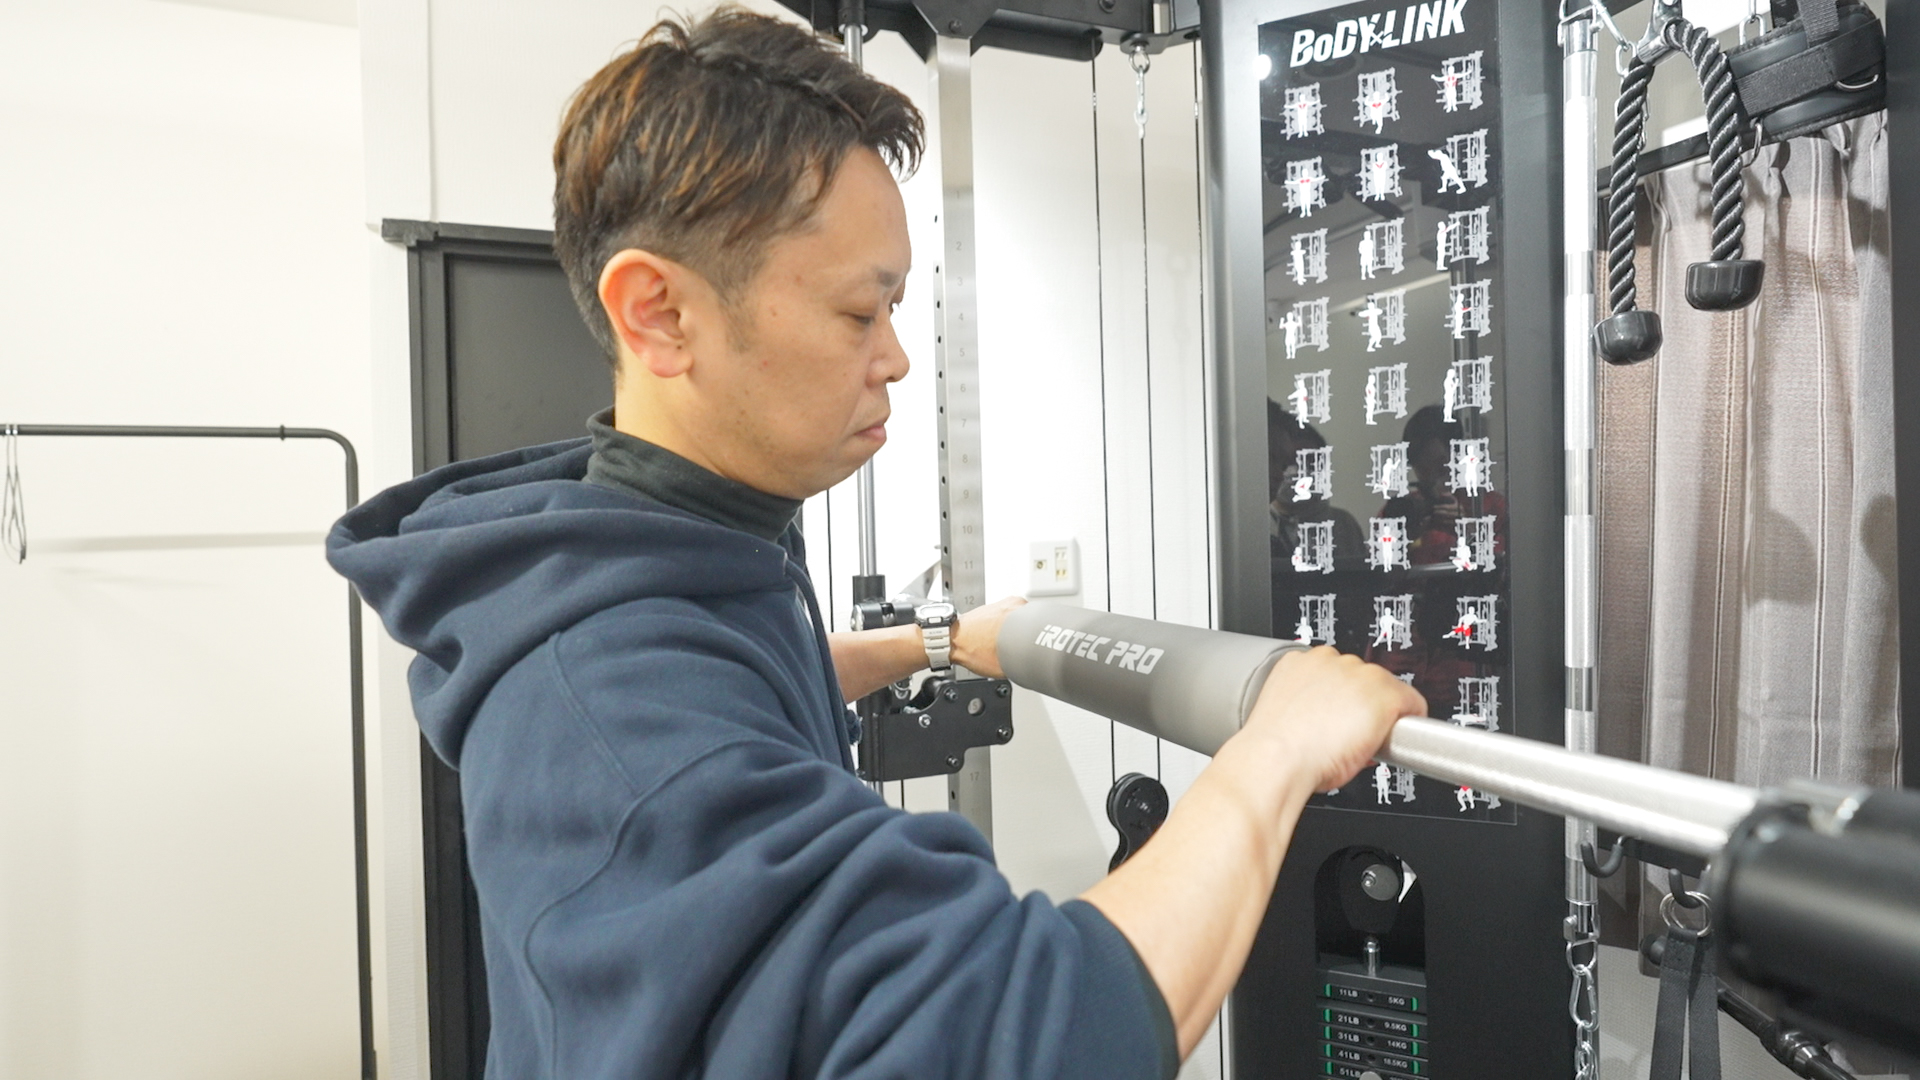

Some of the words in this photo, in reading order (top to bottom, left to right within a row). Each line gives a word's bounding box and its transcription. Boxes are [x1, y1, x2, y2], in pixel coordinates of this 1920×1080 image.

[956, 241, 962, 250] 2
[957, 277, 963, 286] 3
[958, 313, 964, 321] 4
[960, 348, 965, 357] 5
[960, 383, 966, 393] 6
[961, 419, 967, 428] 7
[962, 454, 968, 463] 8
[963, 490, 969, 499] 9
[962, 525, 973, 534] 10
[964, 561, 974, 569] 11
[964, 596, 975, 605] 12
[1105, 640, 1165, 675] PRO
[969, 772, 980, 781] 17
[1388, 996, 1405, 1006] 5KG
[1384, 1021, 1407, 1032] 9.5KG
[1387, 1040, 1407, 1050] 14KG
